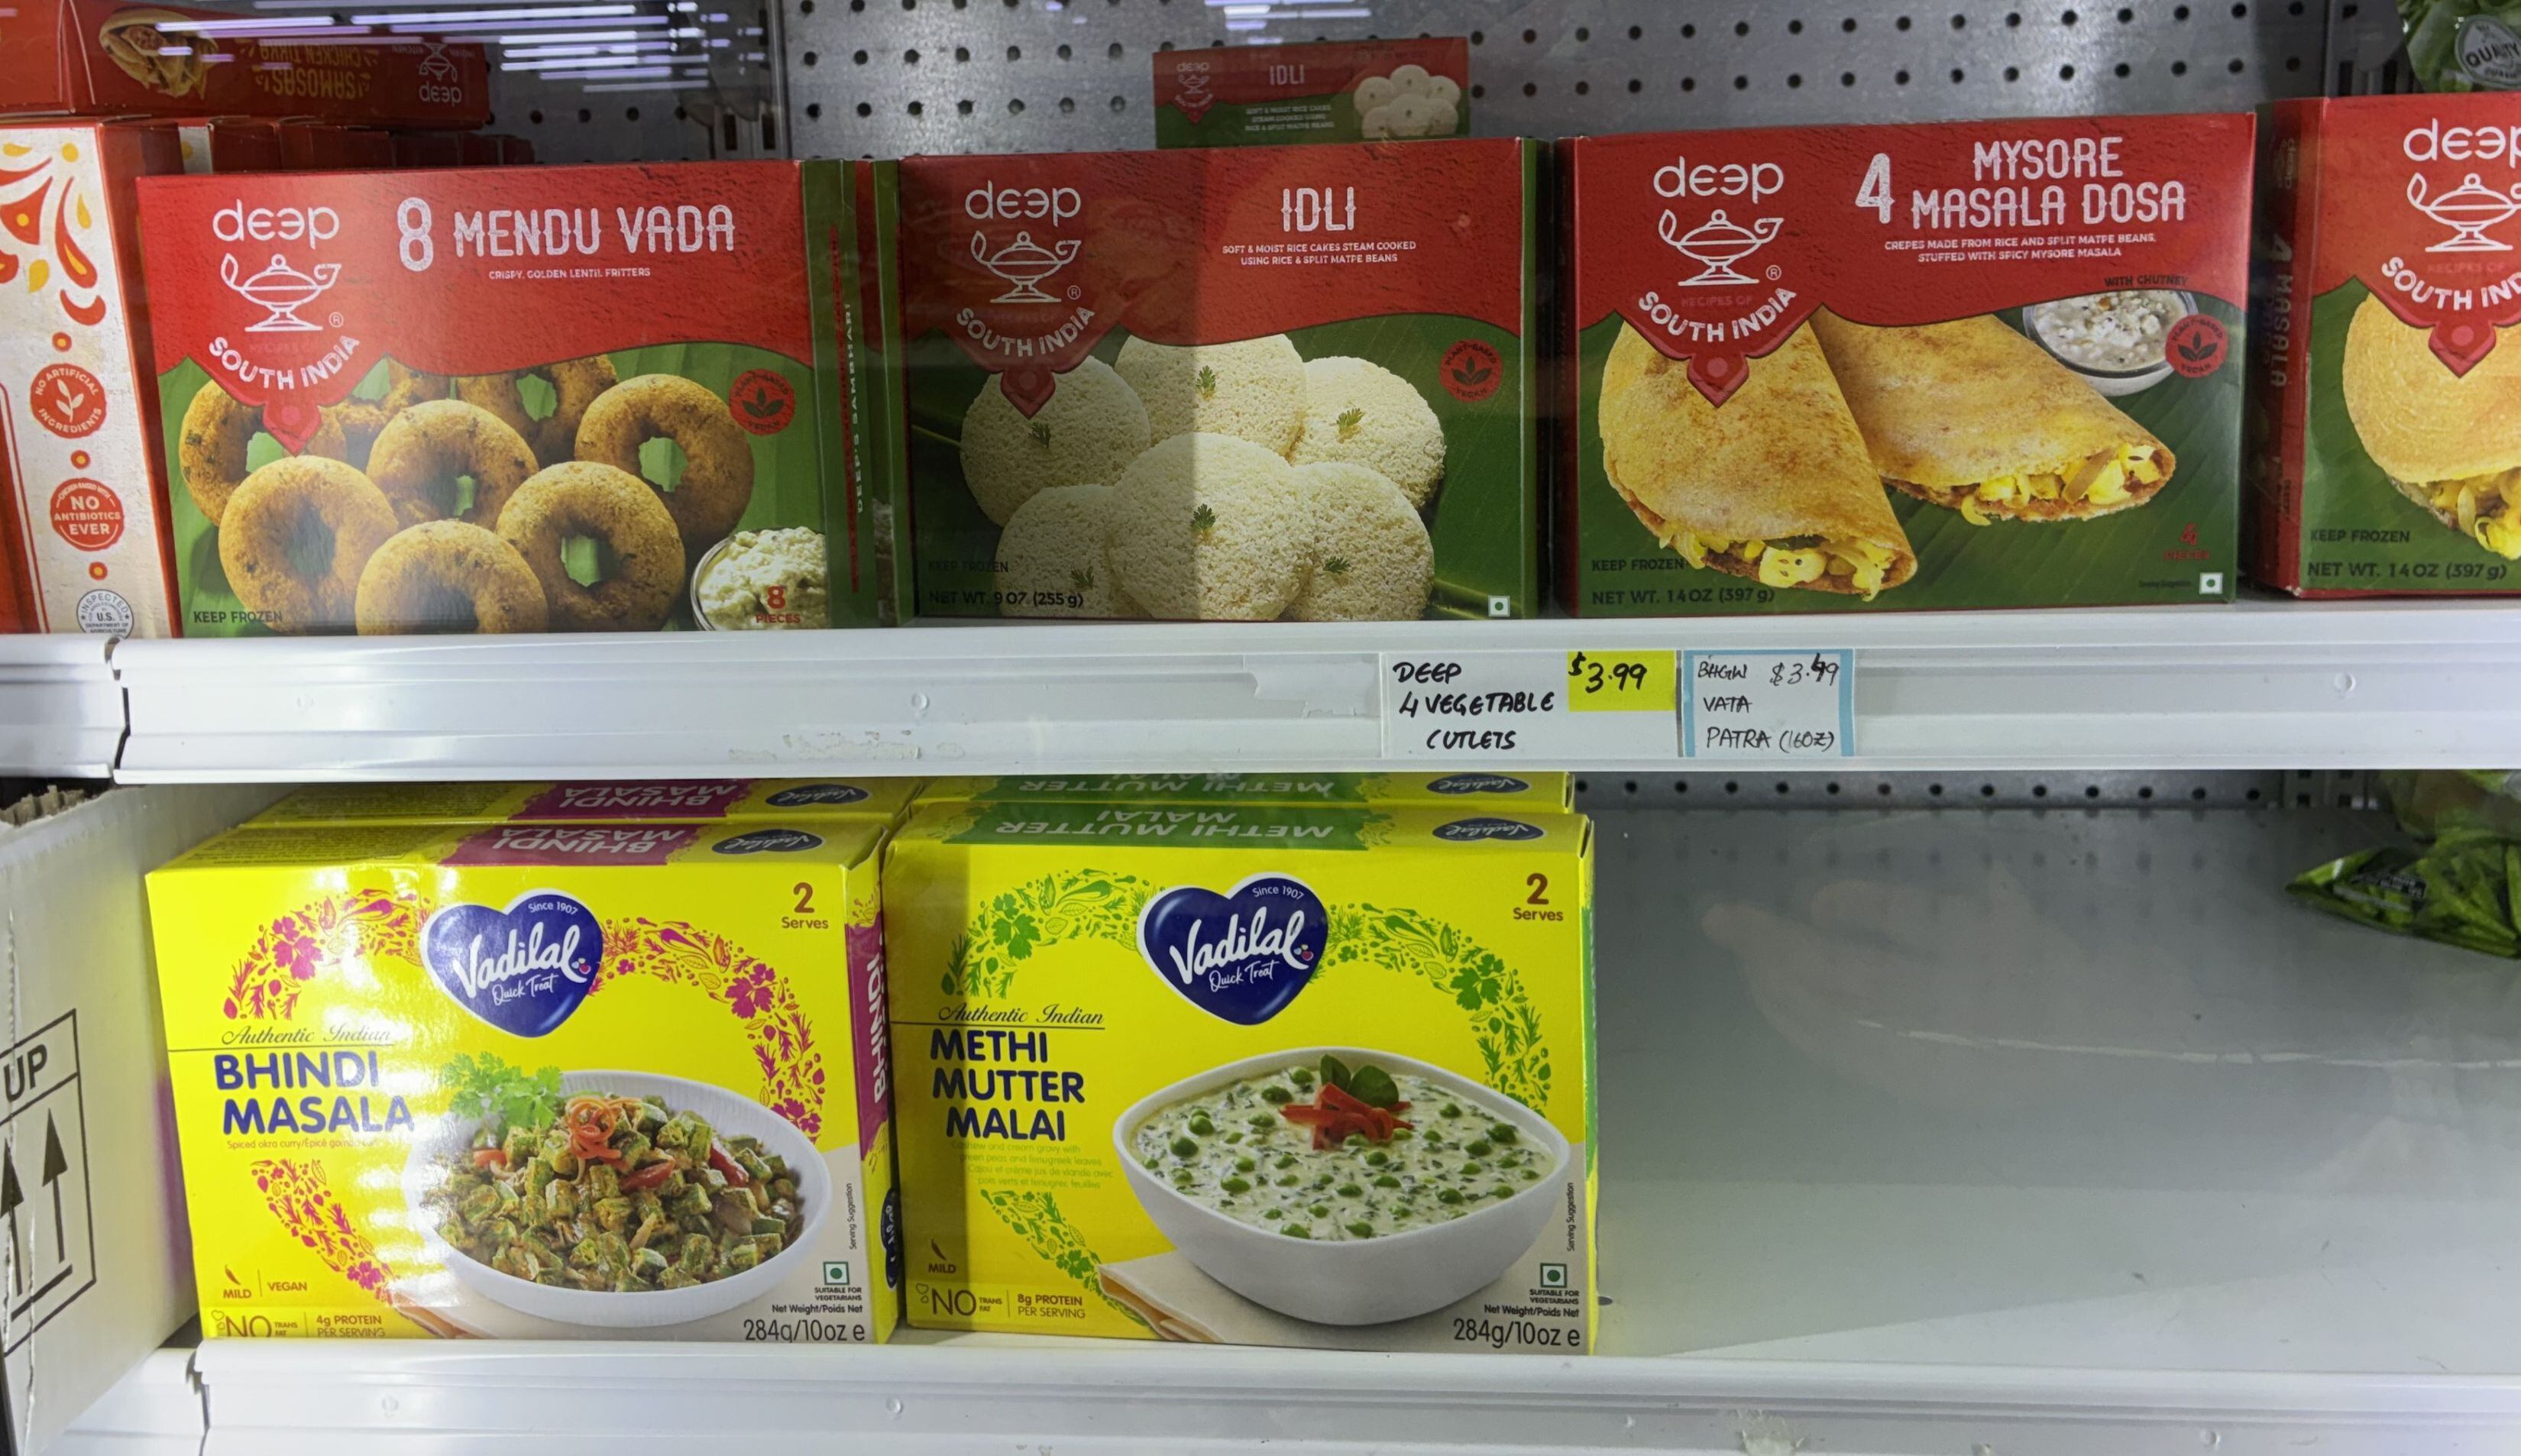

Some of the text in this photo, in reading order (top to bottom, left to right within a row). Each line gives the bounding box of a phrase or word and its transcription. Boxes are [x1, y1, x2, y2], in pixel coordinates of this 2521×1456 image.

[306, 44, 362, 67] CHICKEN
[271, 66, 357, 99] SAMOSAS
[1269, 64, 1305, 86] IDLI
[1972, 136, 2124, 181] MYSORE
[1653, 155, 1784, 205] deep
[1855, 153, 1895, 225] 4
[965, 180, 1082, 228] deep
[1280, 186, 1357, 232] IDLI
[1911, 180, 2186, 229] MASALA DOSA
[212, 199, 340, 250] deep
[396, 197, 736, 272] 8 MENDU VADA
[1222, 241, 1416, 254] SOFT MOIST RICE CAKES STEAM COOKED
[1885, 235, 2115, 250] CREPES MADE FROM RICE AND SPLIT MATPE
[1241, 254, 1397, 265] USING RICE SPLIT MATPE BEANS
[1917, 248, 2121, 262] STUFFED WITH SPICY MYSORE MASALA
[526, 267, 651, 280] GOLDEN LENTIL FRITTERS
[2104, 274, 2189, 287] WITH CHUTNEY
[2381, 257, 2472, 310] SOUTH
[1681, 296, 1733, 306] RECIPES
[1639, 287, 1797, 343] SOUTH INDIA
[956, 306, 1095, 358] SOUTH INDIA
[2270, 275, 2294, 387] MASALA
[209, 335, 361, 390] SOUTH INDIA
[35, 367, 99, 396] NO ARTIFICIAL
[38, 408, 102, 433] INGREDIENTS
[850, 434, 863, 513] DEEP'S
[70, 496, 99, 510] NO
[54, 512, 121, 521] ANTIBIOTICS
[69, 523, 110, 535] EVER
[2310, 530, 2410, 542] KEEP FROZEN
[1592, 558, 1684, 571] KEEP FROZEN
[2308, 563, 2380, 578] NET WT.
[80, 593, 129, 614] INSPECTED
[767, 586, 786, 609] 8
[929, 592, 958, 603] NET
[1592, 590, 1660, 604] NET WT.
[97, 612, 115, 622] U.S.
[194, 611, 283, 623] KEEP FROZEN
[756, 613, 801, 624] PIECES
[1393, 662, 1461, 684] DEEP
[1568, 652, 1647, 693] $3.99
[1400, 691, 1555, 717] 4 VEGETABLE
[1704, 696, 1752, 713] VATA
[1426, 730, 1517, 749] CUTLETS
[1707, 727, 1772, 749] PATRA
[564, 785, 738, 797] MASALA
[1018, 781, 1335, 793] METHI MUTTER
[558, 794, 713, 808] BHINDI
[1096, 811, 1238, 823] MALAI
[501, 829, 686, 840] MASALA
[995, 821, 1335, 838] METHI MUTTER
[491, 838, 656, 854] BHINDI
[793, 882, 815, 913] 2
[1252, 886, 1304, 900] Since 1907
[1526, 872, 1549, 905] 2
[528, 901, 579, 915] Since 1907
[1513, 907, 1564, 921] Serves
[782, 917, 829, 929] Serves
[1170, 906, 1309, 985] Vadilal
[452, 921, 587, 999] Vadilal
[1209, 959, 1280, 993] Quick Treat
[492, 973, 559, 1006] Quick Treat
[938, 1002, 1104, 1024] Authentic Indian
[222, 1022, 391, 1045] Authentic Indian
[930, 1028, 1048, 1063] METHI
[3, 1043, 47, 1102] UP
[214, 1050, 379, 1090] BHINDI
[933, 1067, 1086, 1104] MUTTER
[223, 1095, 416, 1135] MASALA
[946, 1106, 1066, 1142] MALAI
[227, 1140, 255, 1150] Spiced
[846, 1183, 857, 1250] Serving Suggestion
[1567, 1183, 1575, 1251] Serving Suggestion
[928, 1263, 956, 1273] MILD
[223, 1289, 251, 1299] MILD
[267, 1282, 307, 1292] VEGAN
[772, 1304, 862, 1313] Net Net
[931, 1289, 976, 1316] NO
[1018, 1294, 1083, 1306] 8g PROTEIN
[316, 1315, 382, 1327] 4g PROTEIN
[1018, 1306, 1086, 1319] PER SERVING
[1484, 1305, 1579, 1317] Net Net
[225, 1315, 272, 1337] NO
[317, 1328, 386, 1337] PER SERVING
